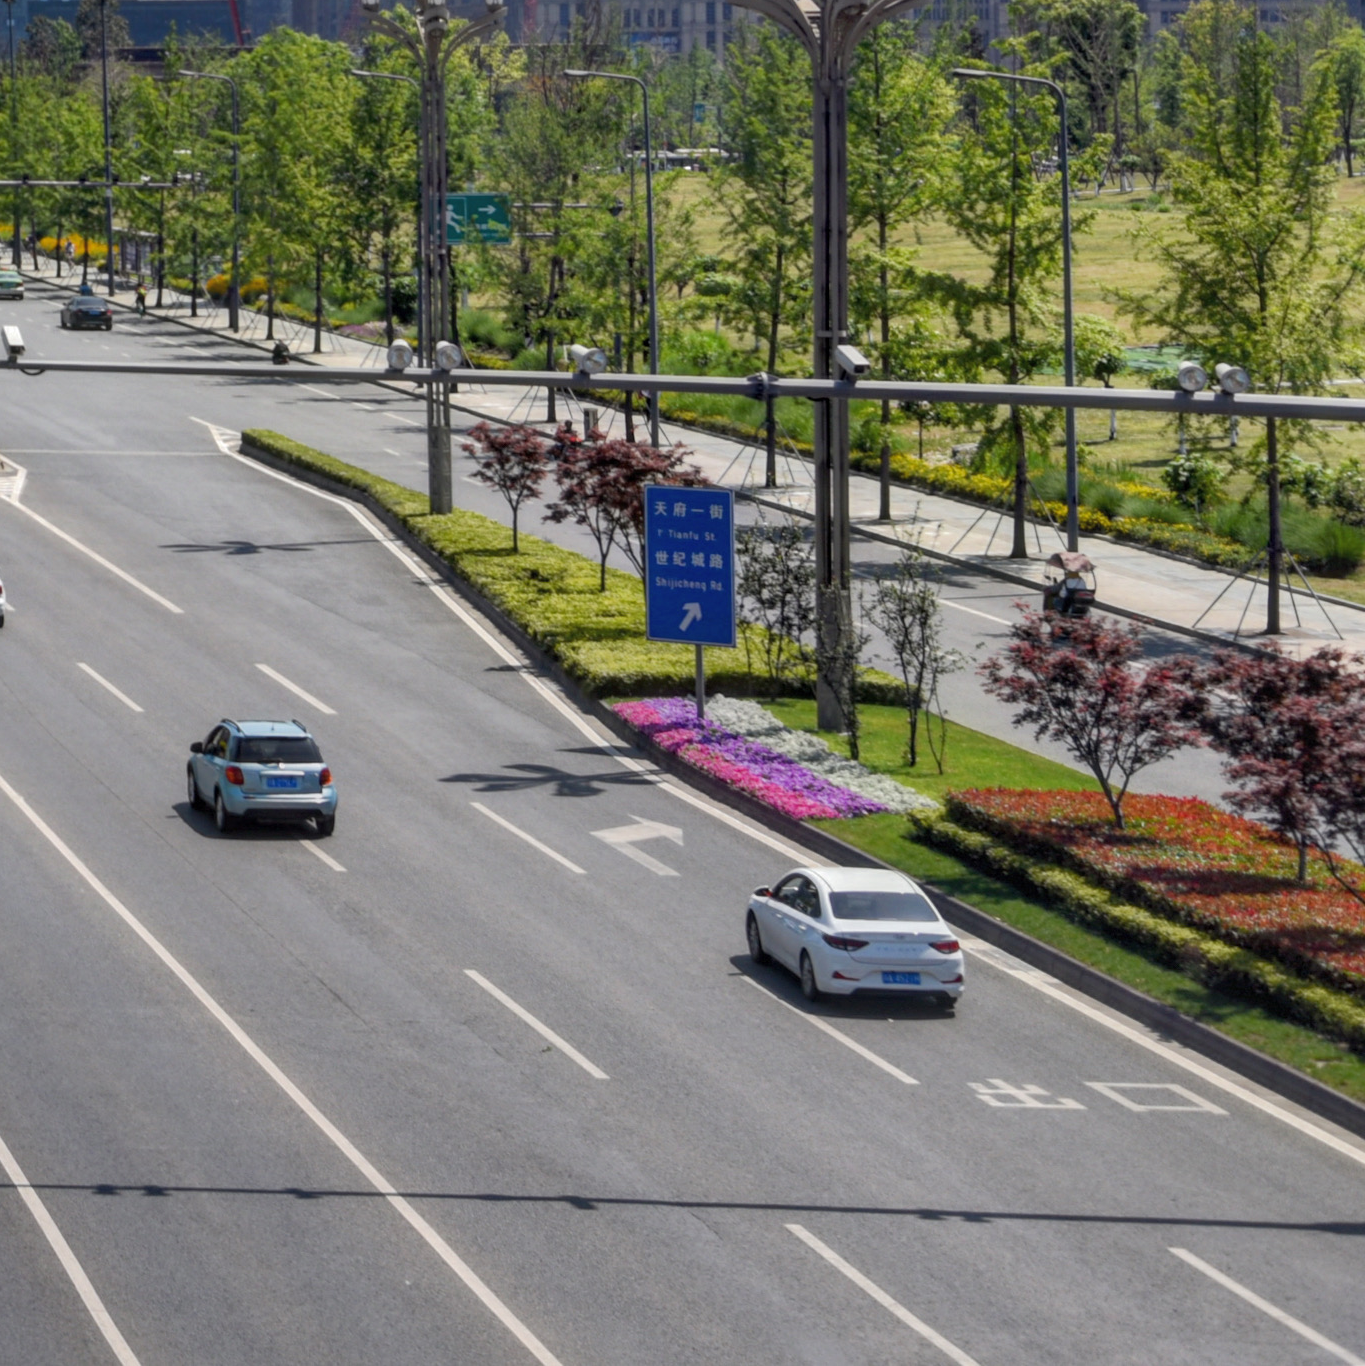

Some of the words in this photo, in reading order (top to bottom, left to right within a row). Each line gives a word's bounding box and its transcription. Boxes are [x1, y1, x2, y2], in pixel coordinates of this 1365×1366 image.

[654, 501, 724, 520] 天府一街
[668, 528, 699, 541] Tianfu
[655, 550, 724, 570] 世纪城路
[655, 576, 707, 593] Shijicheng
[966, 1078, 1231, 1115] 出口
